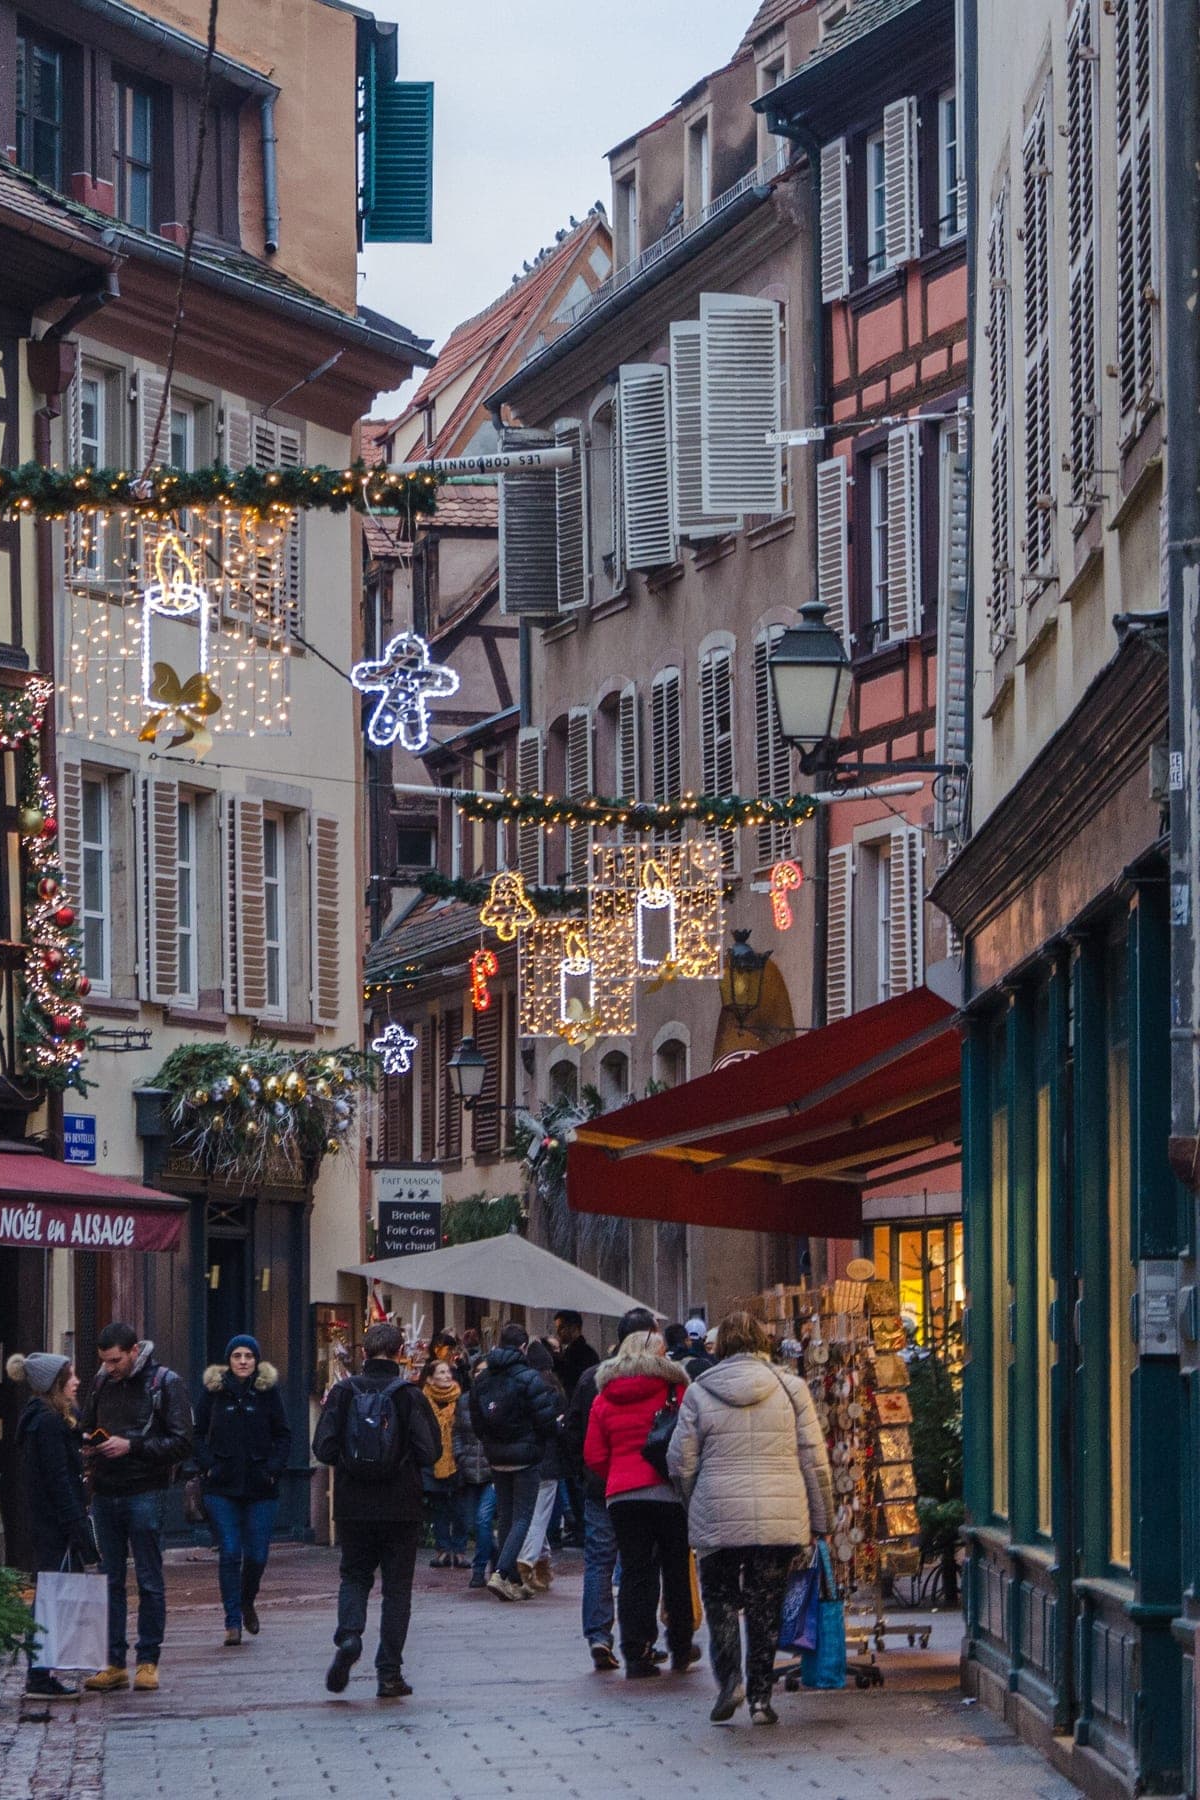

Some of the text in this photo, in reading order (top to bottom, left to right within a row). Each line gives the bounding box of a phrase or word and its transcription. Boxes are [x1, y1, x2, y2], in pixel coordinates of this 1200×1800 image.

[519, 454, 541, 467] LES
[382, 1176, 440, 1186] FAIT MAISON
[391, 1210, 431, 1220] Bredele
[0, 1202, 43, 1241] NOËL
[47, 1219, 66, 1242] en
[70, 1212, 136, 1247] ALSACE
[386, 1225, 435, 1236] Foie Gras
[385, 1240, 436, 1251] Vin chaud
